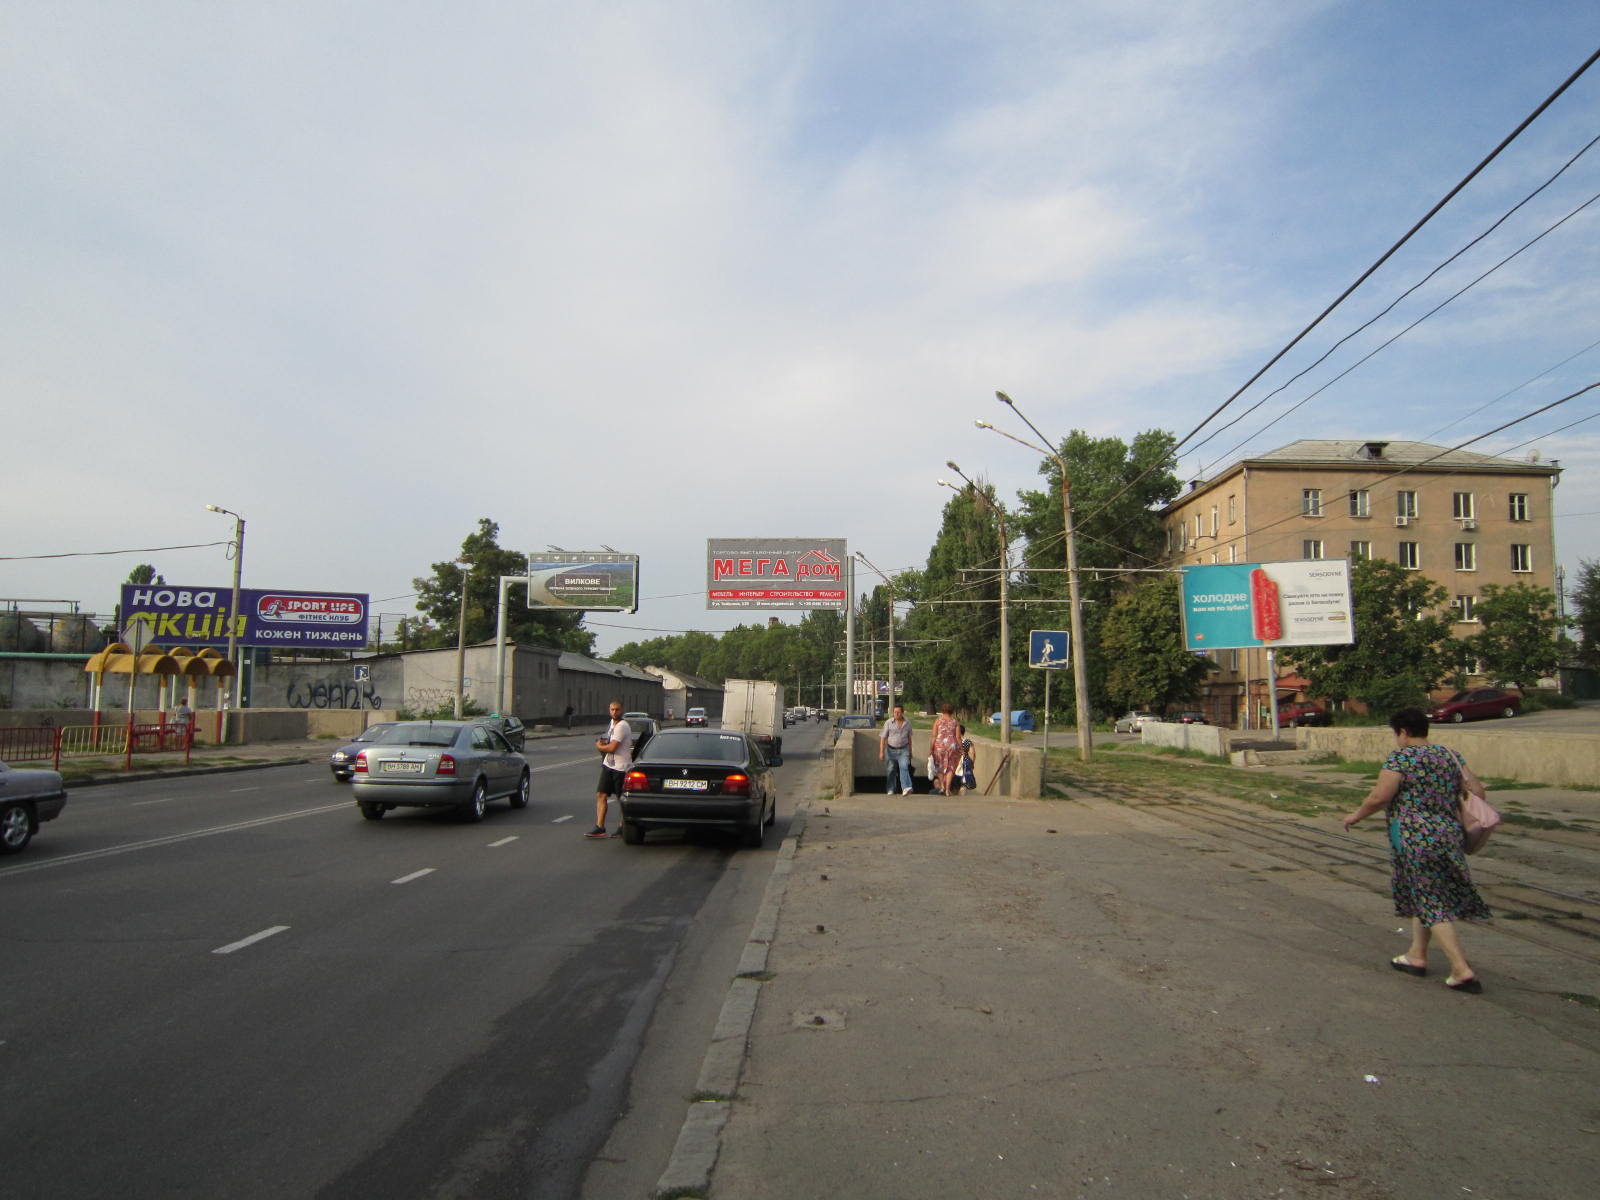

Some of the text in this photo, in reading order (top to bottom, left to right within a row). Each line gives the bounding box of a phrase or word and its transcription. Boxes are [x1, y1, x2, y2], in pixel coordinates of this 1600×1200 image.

[713, 558, 840, 581] МЕГА ДОМ
[1192, 592, 1248, 604] холодне
[287, 600, 355, 612] SPORT LIFE
[329, 614, 350, 622] КЛУБ
[255, 629, 363, 641] кожен тиждень
[668, 779, 707, 788] BH 9212 CM
